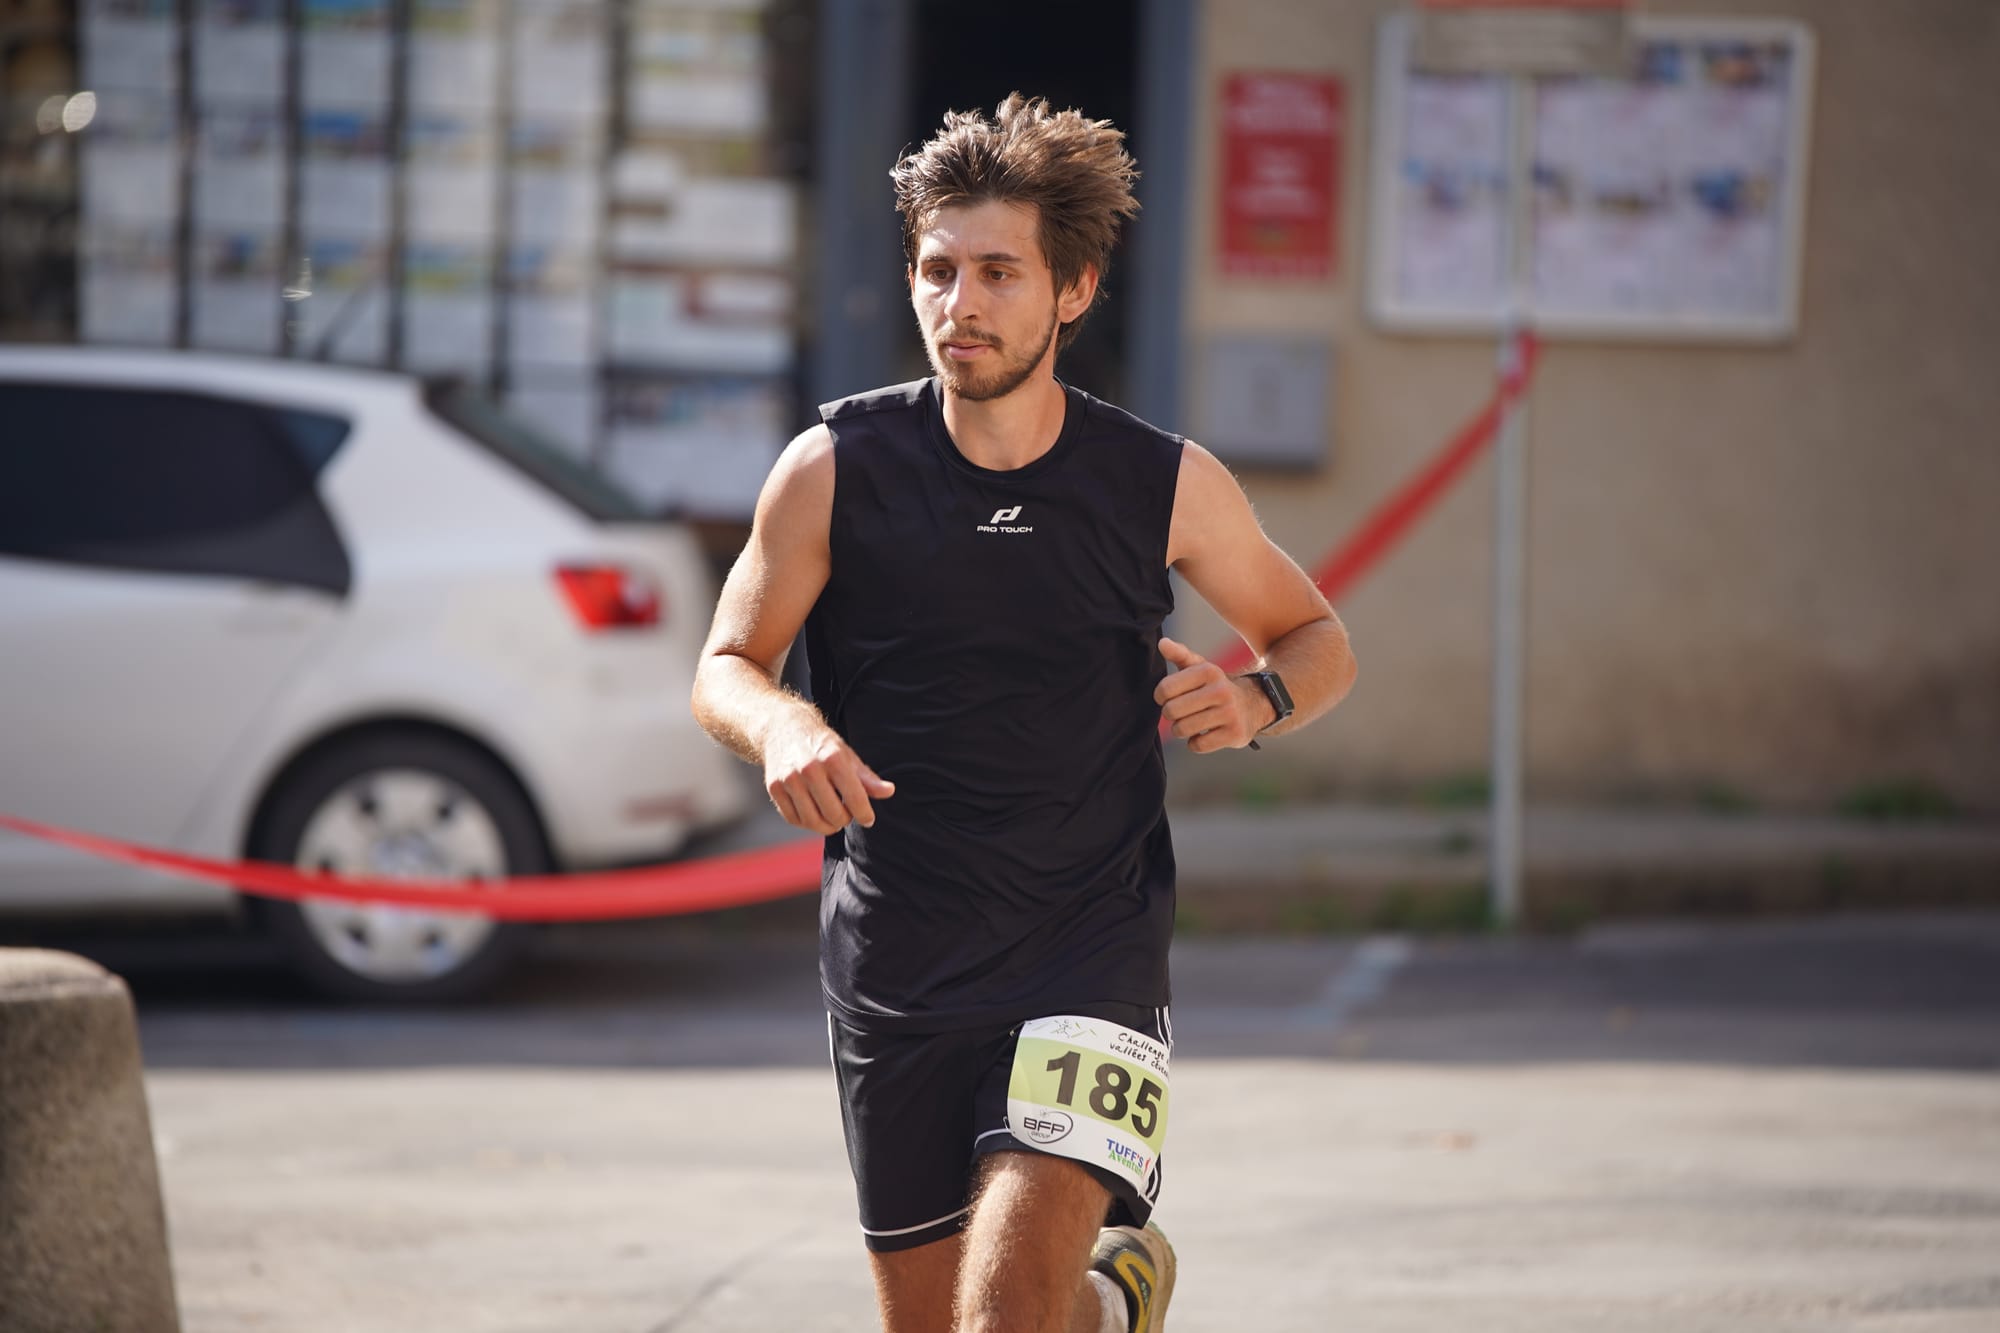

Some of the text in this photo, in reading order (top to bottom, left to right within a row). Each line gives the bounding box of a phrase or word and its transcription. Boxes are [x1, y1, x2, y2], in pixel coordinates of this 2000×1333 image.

[977, 525, 997, 533] PRO
[1109, 1043, 1147, 1062] vallées
[1118, 1032, 1165, 1060] Challenge
[1046, 1050, 1163, 1139] 185
[1023, 1116, 1066, 1135] BFP
[1106, 1138, 1144, 1169] TUFF'S
